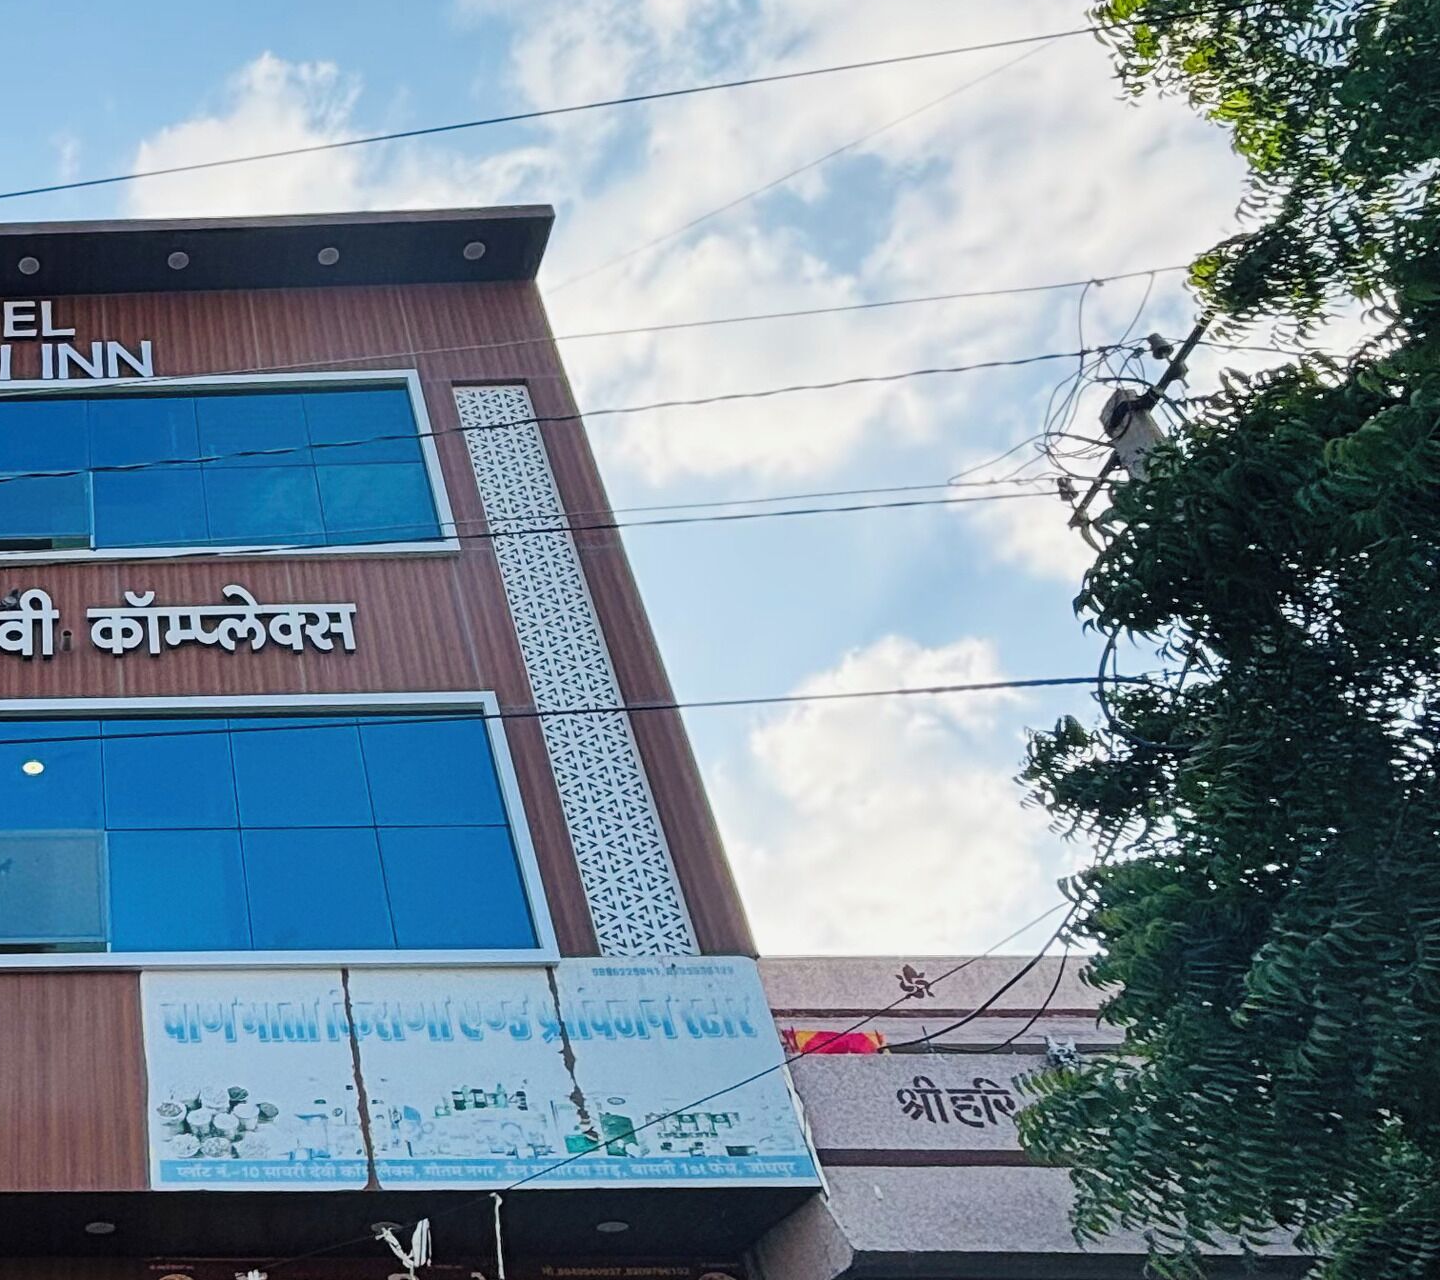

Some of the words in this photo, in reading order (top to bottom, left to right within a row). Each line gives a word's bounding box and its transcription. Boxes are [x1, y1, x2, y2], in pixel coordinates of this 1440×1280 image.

[41, 340, 154, 380] INN
[86, 585, 357, 655] कॉम्प्लेक्स
[896, 1075, 949, 1124] श्री
